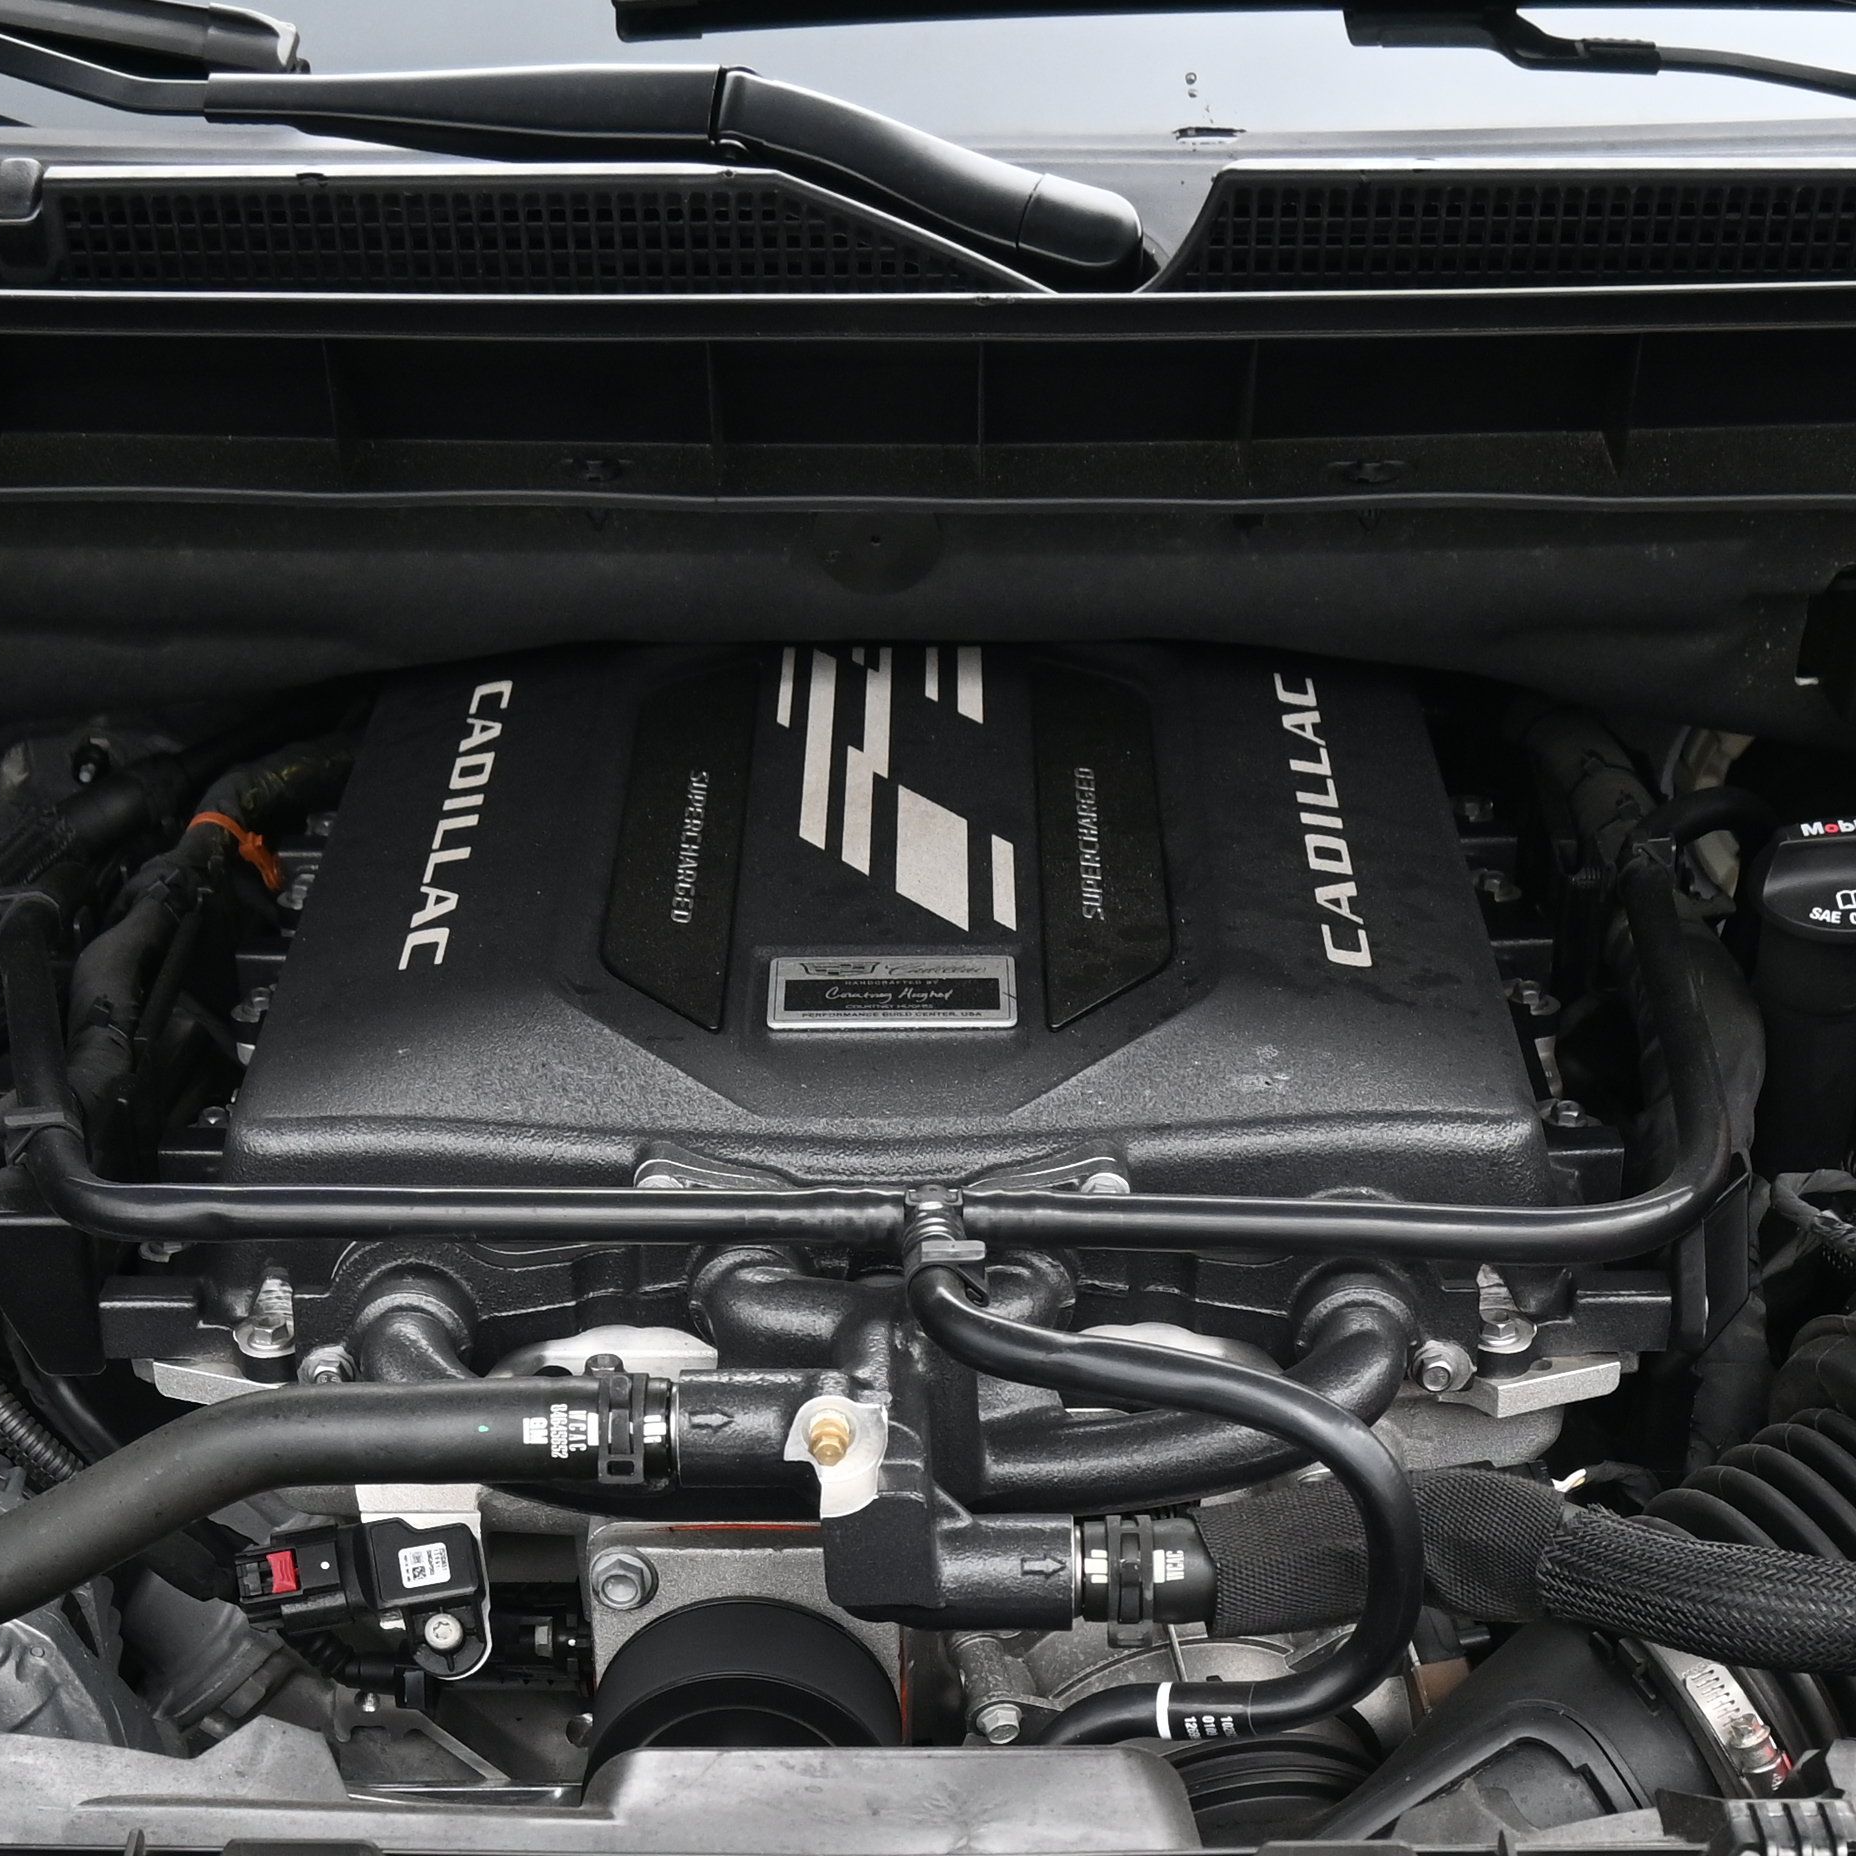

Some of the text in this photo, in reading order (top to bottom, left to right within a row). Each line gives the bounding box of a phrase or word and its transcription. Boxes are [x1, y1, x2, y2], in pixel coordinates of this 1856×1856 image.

[397, 679, 514, 971] CADILLAC
[670, 769, 711, 924] SUPERCHARGED
[1073, 766, 1106, 921] SUPERCHARGED
[1273, 672, 1373, 968] CADILLAC
[1809, 906, 1842, 924] SAE
